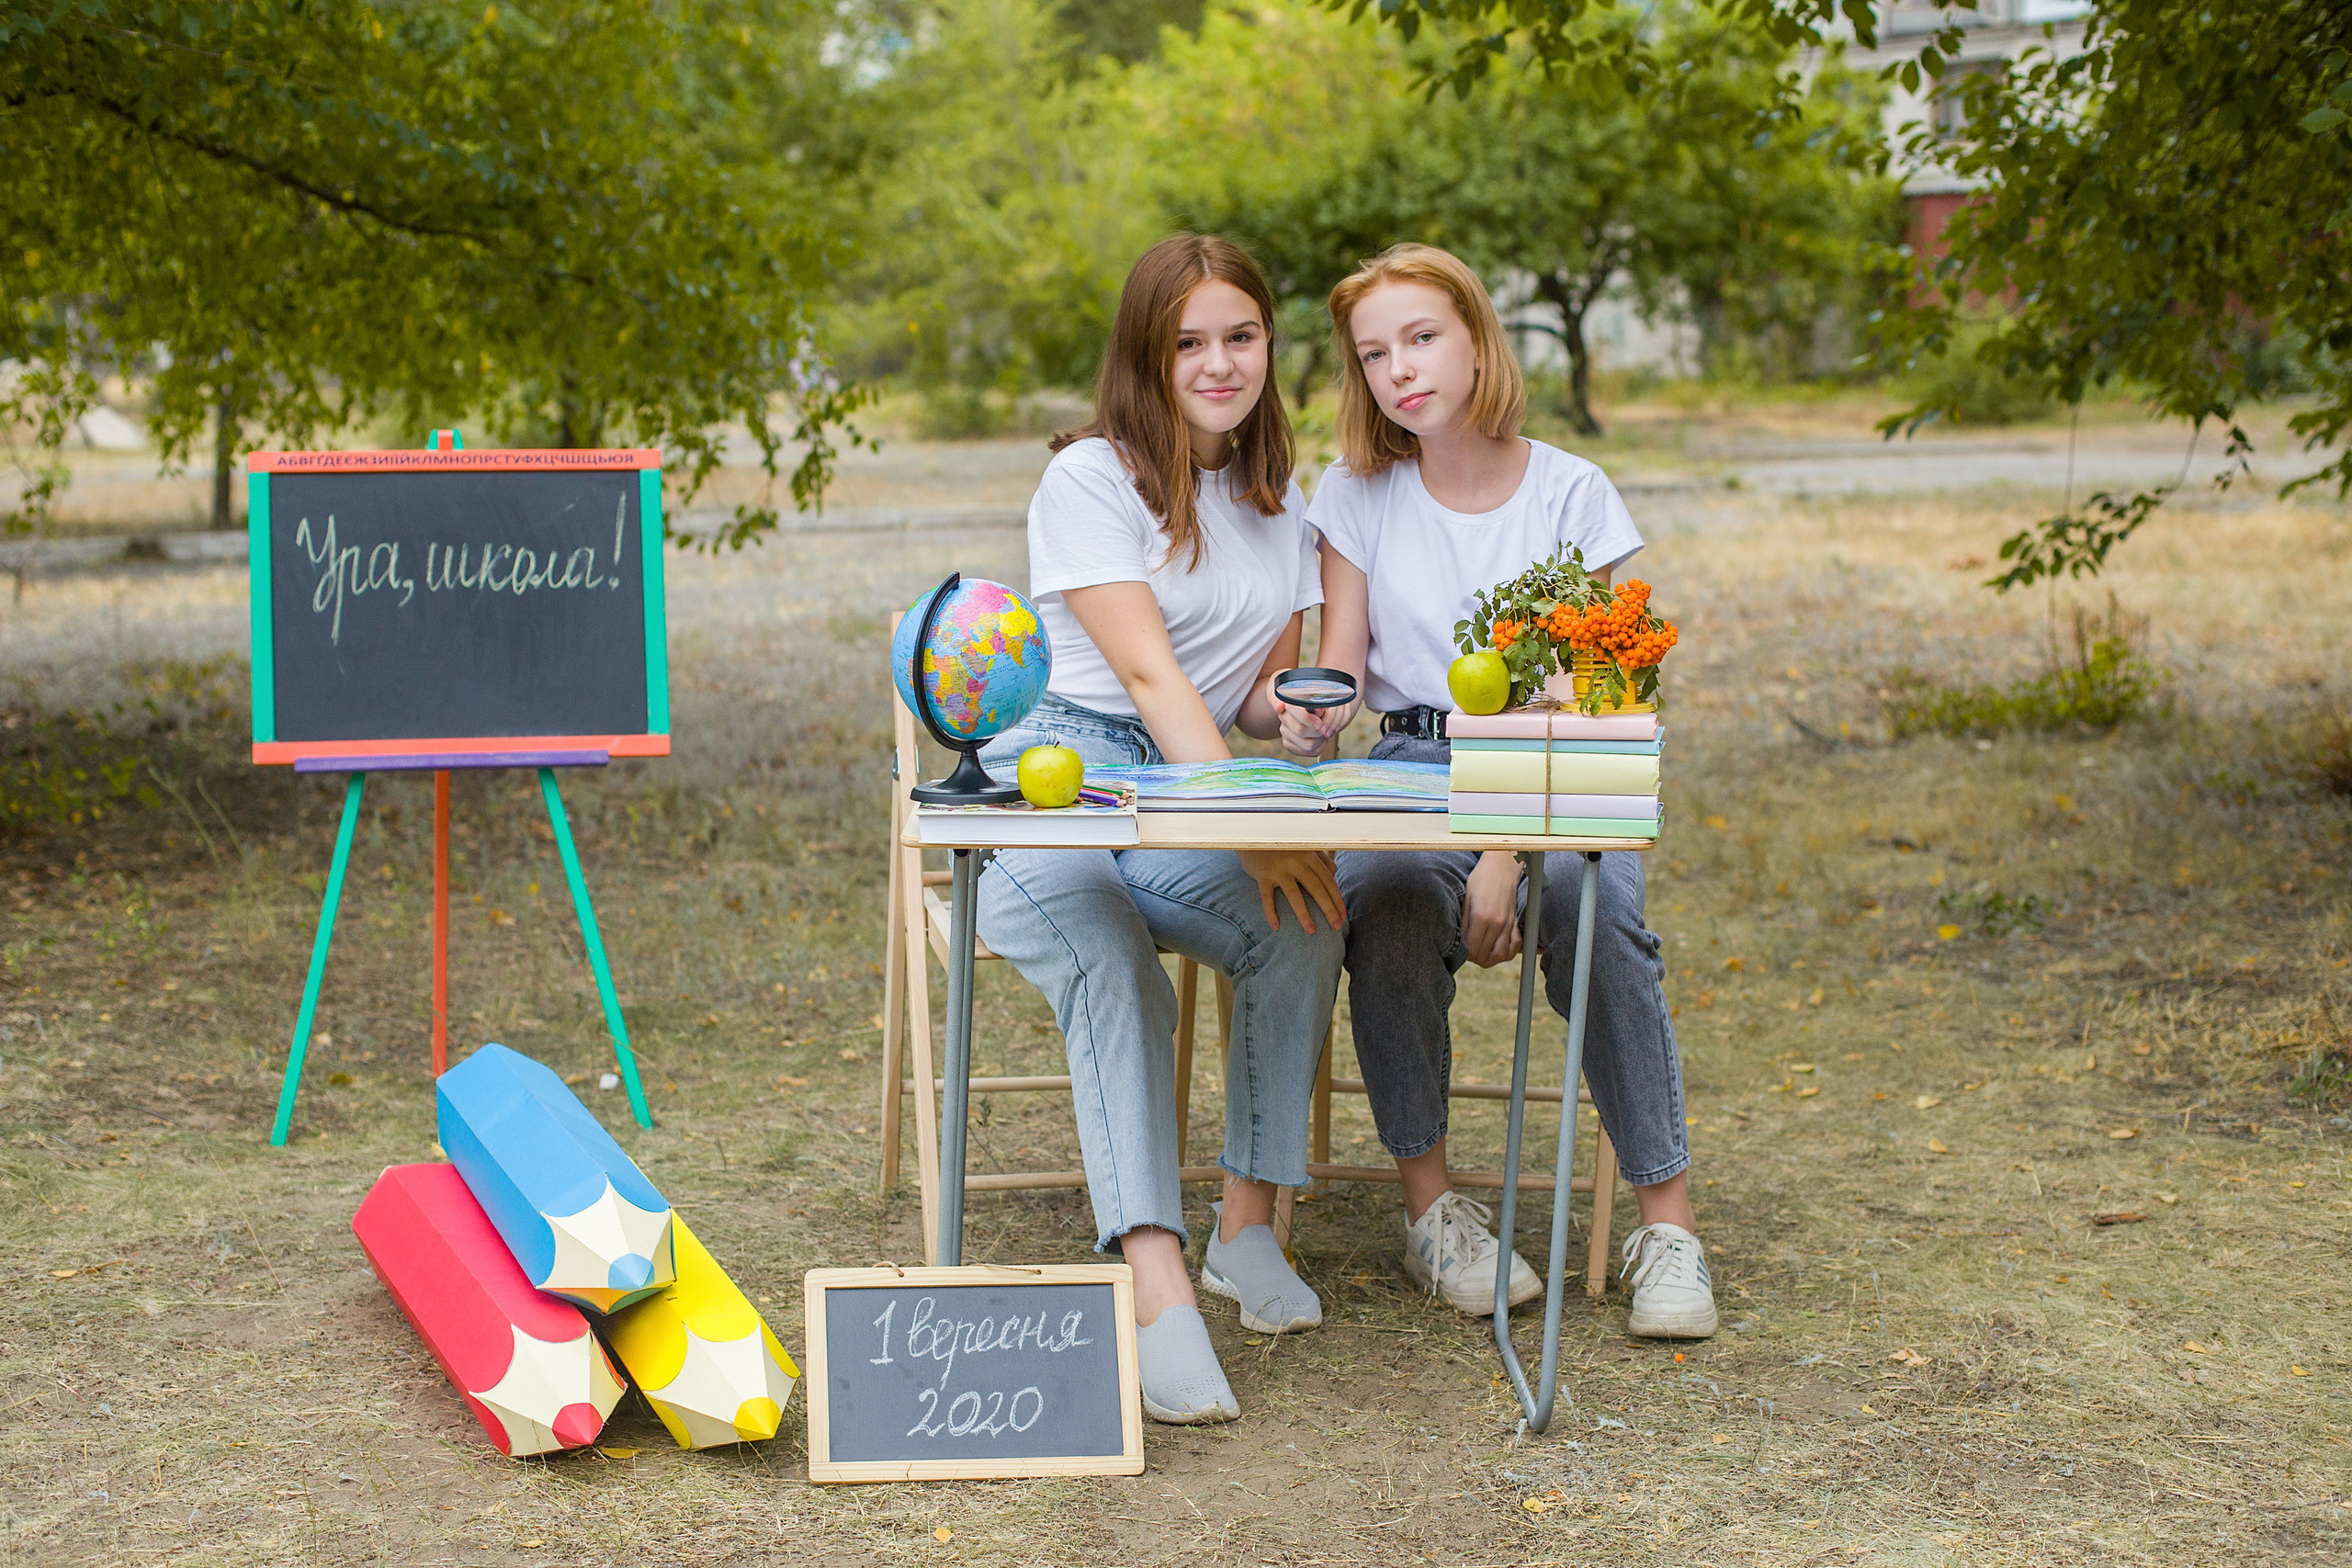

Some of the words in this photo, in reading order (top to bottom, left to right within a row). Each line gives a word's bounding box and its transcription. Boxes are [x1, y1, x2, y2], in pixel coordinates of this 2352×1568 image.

[296, 513, 414, 645] Ура,
[426, 491, 627, 595] школа!
[869, 1300, 897, 1365] 1
[907, 1296, 1094, 1391] вересня
[907, 1386, 1044, 1438] 2020
